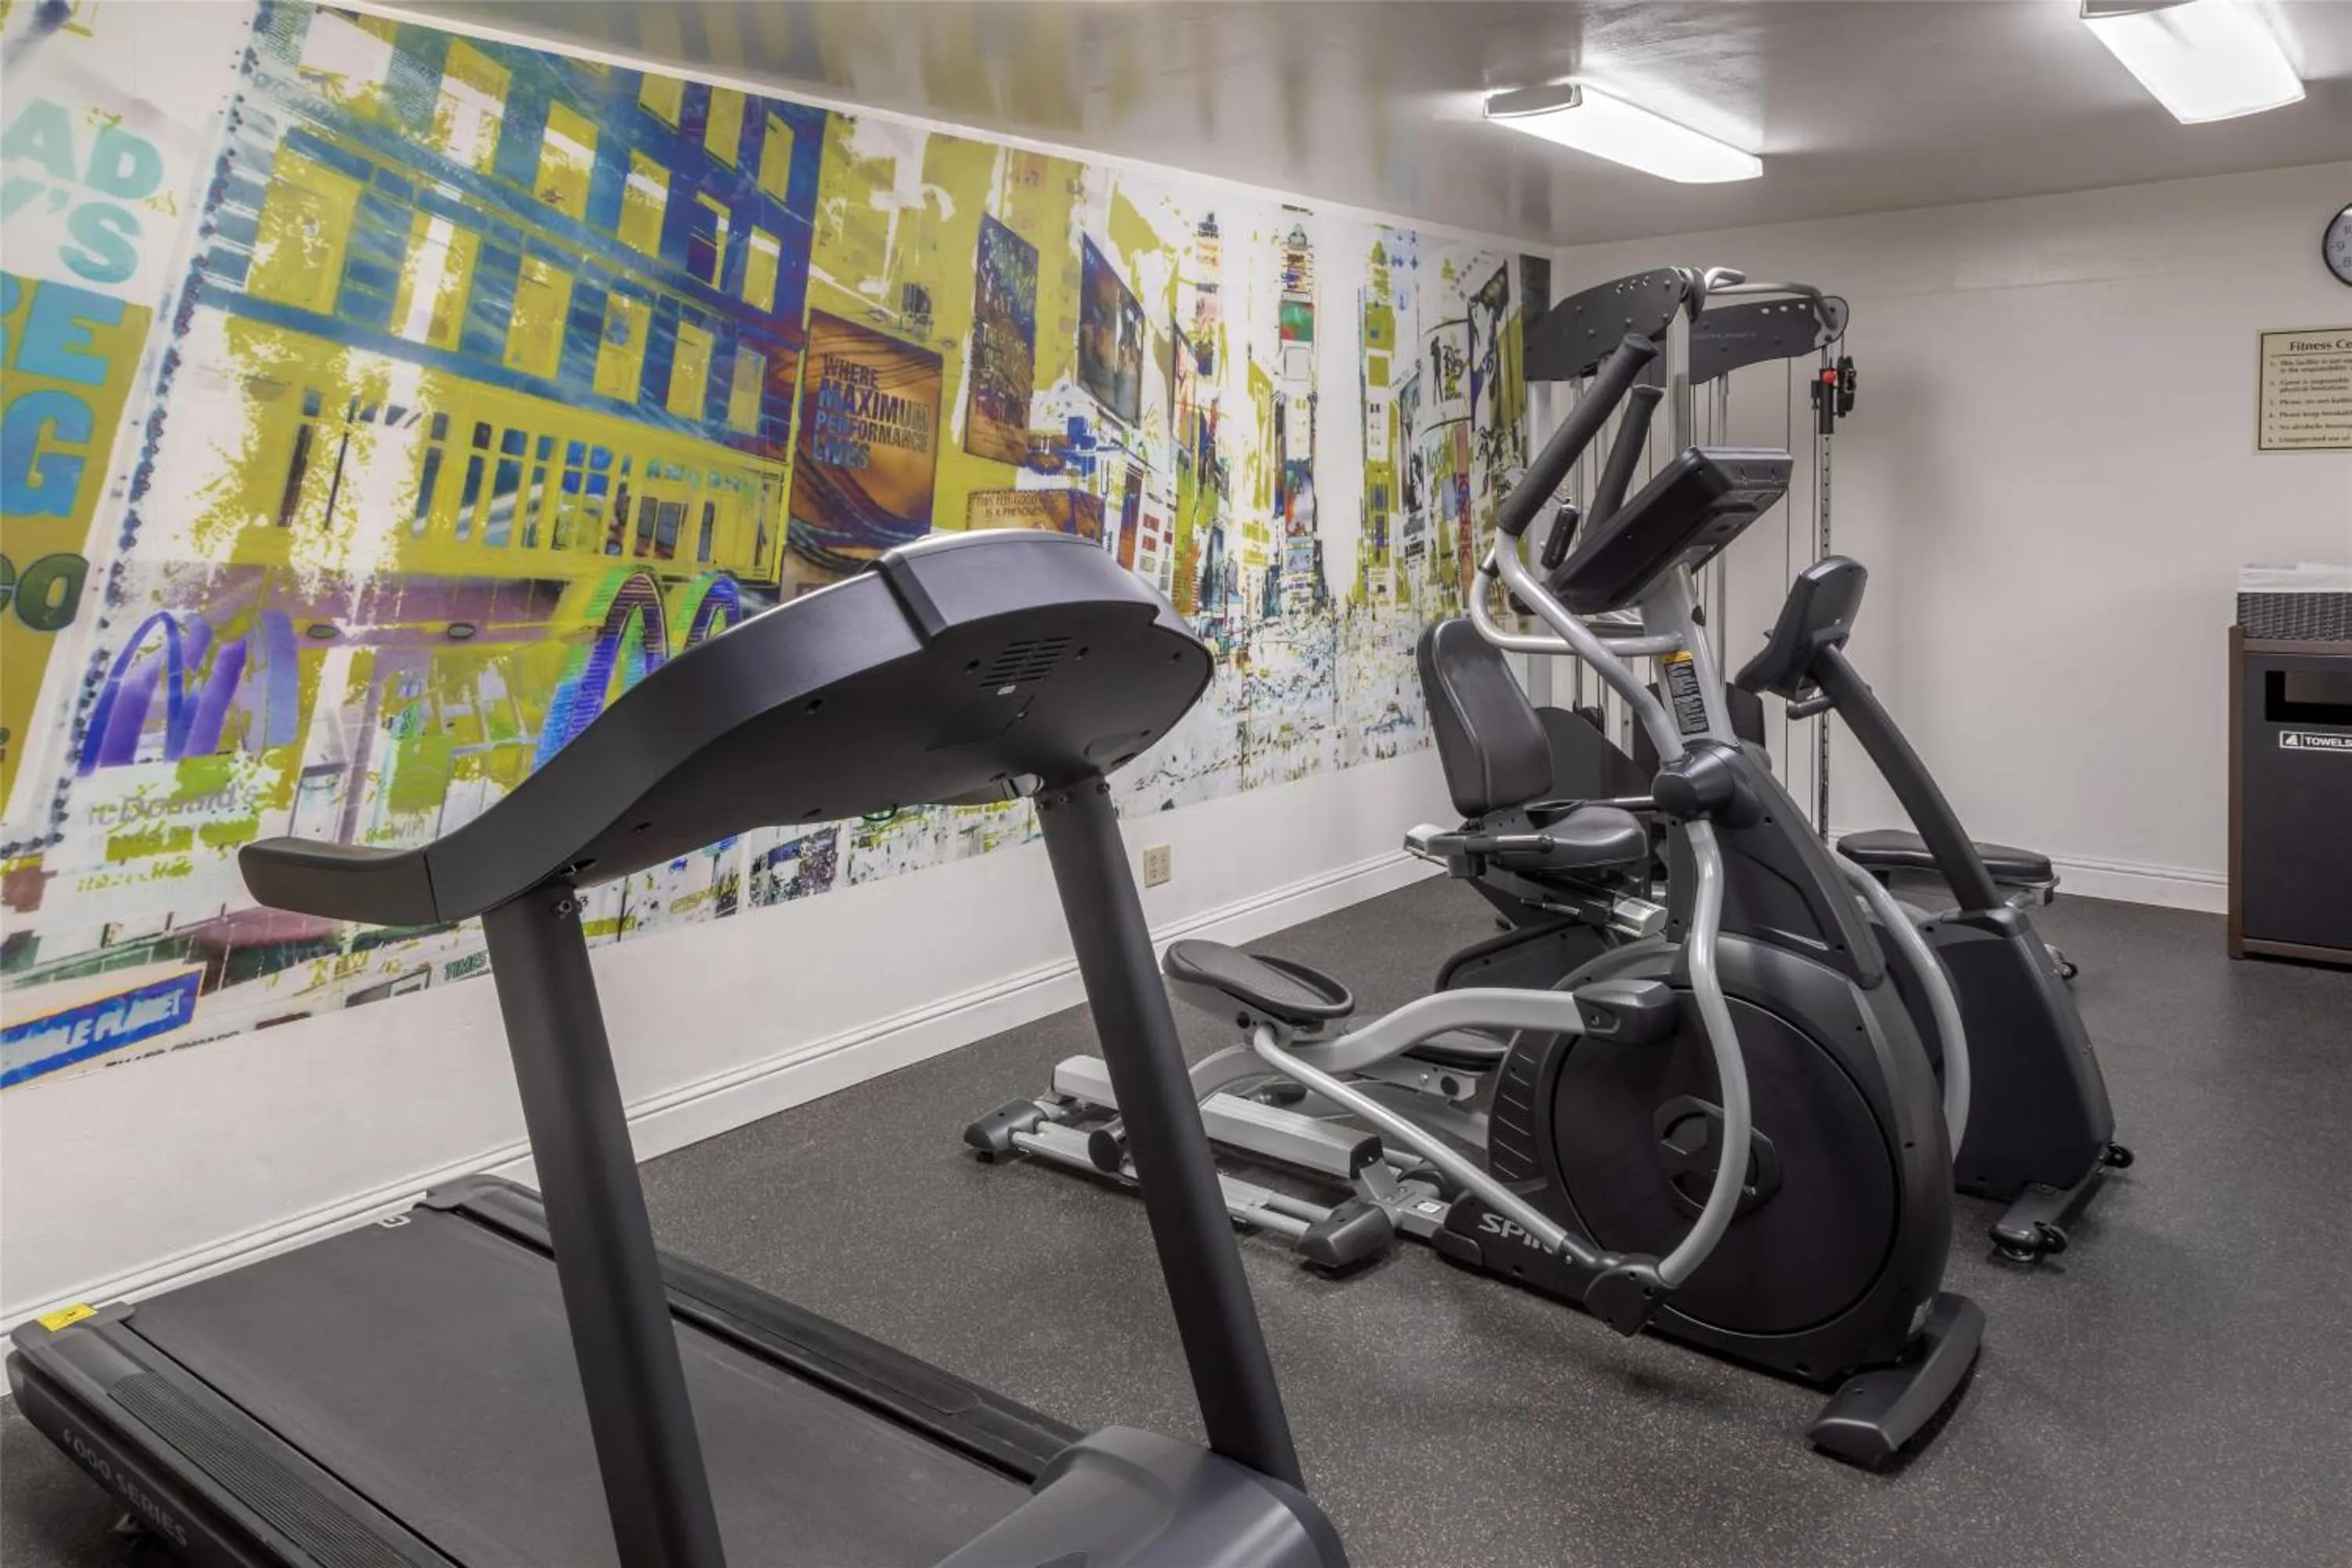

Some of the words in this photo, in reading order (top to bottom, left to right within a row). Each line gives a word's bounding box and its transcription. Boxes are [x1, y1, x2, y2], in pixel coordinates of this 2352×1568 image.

[2289, 340, 2332, 352] Fitness
[823, 354, 878, 390] WHERE
[818, 378, 930, 434] MAXIMUM
